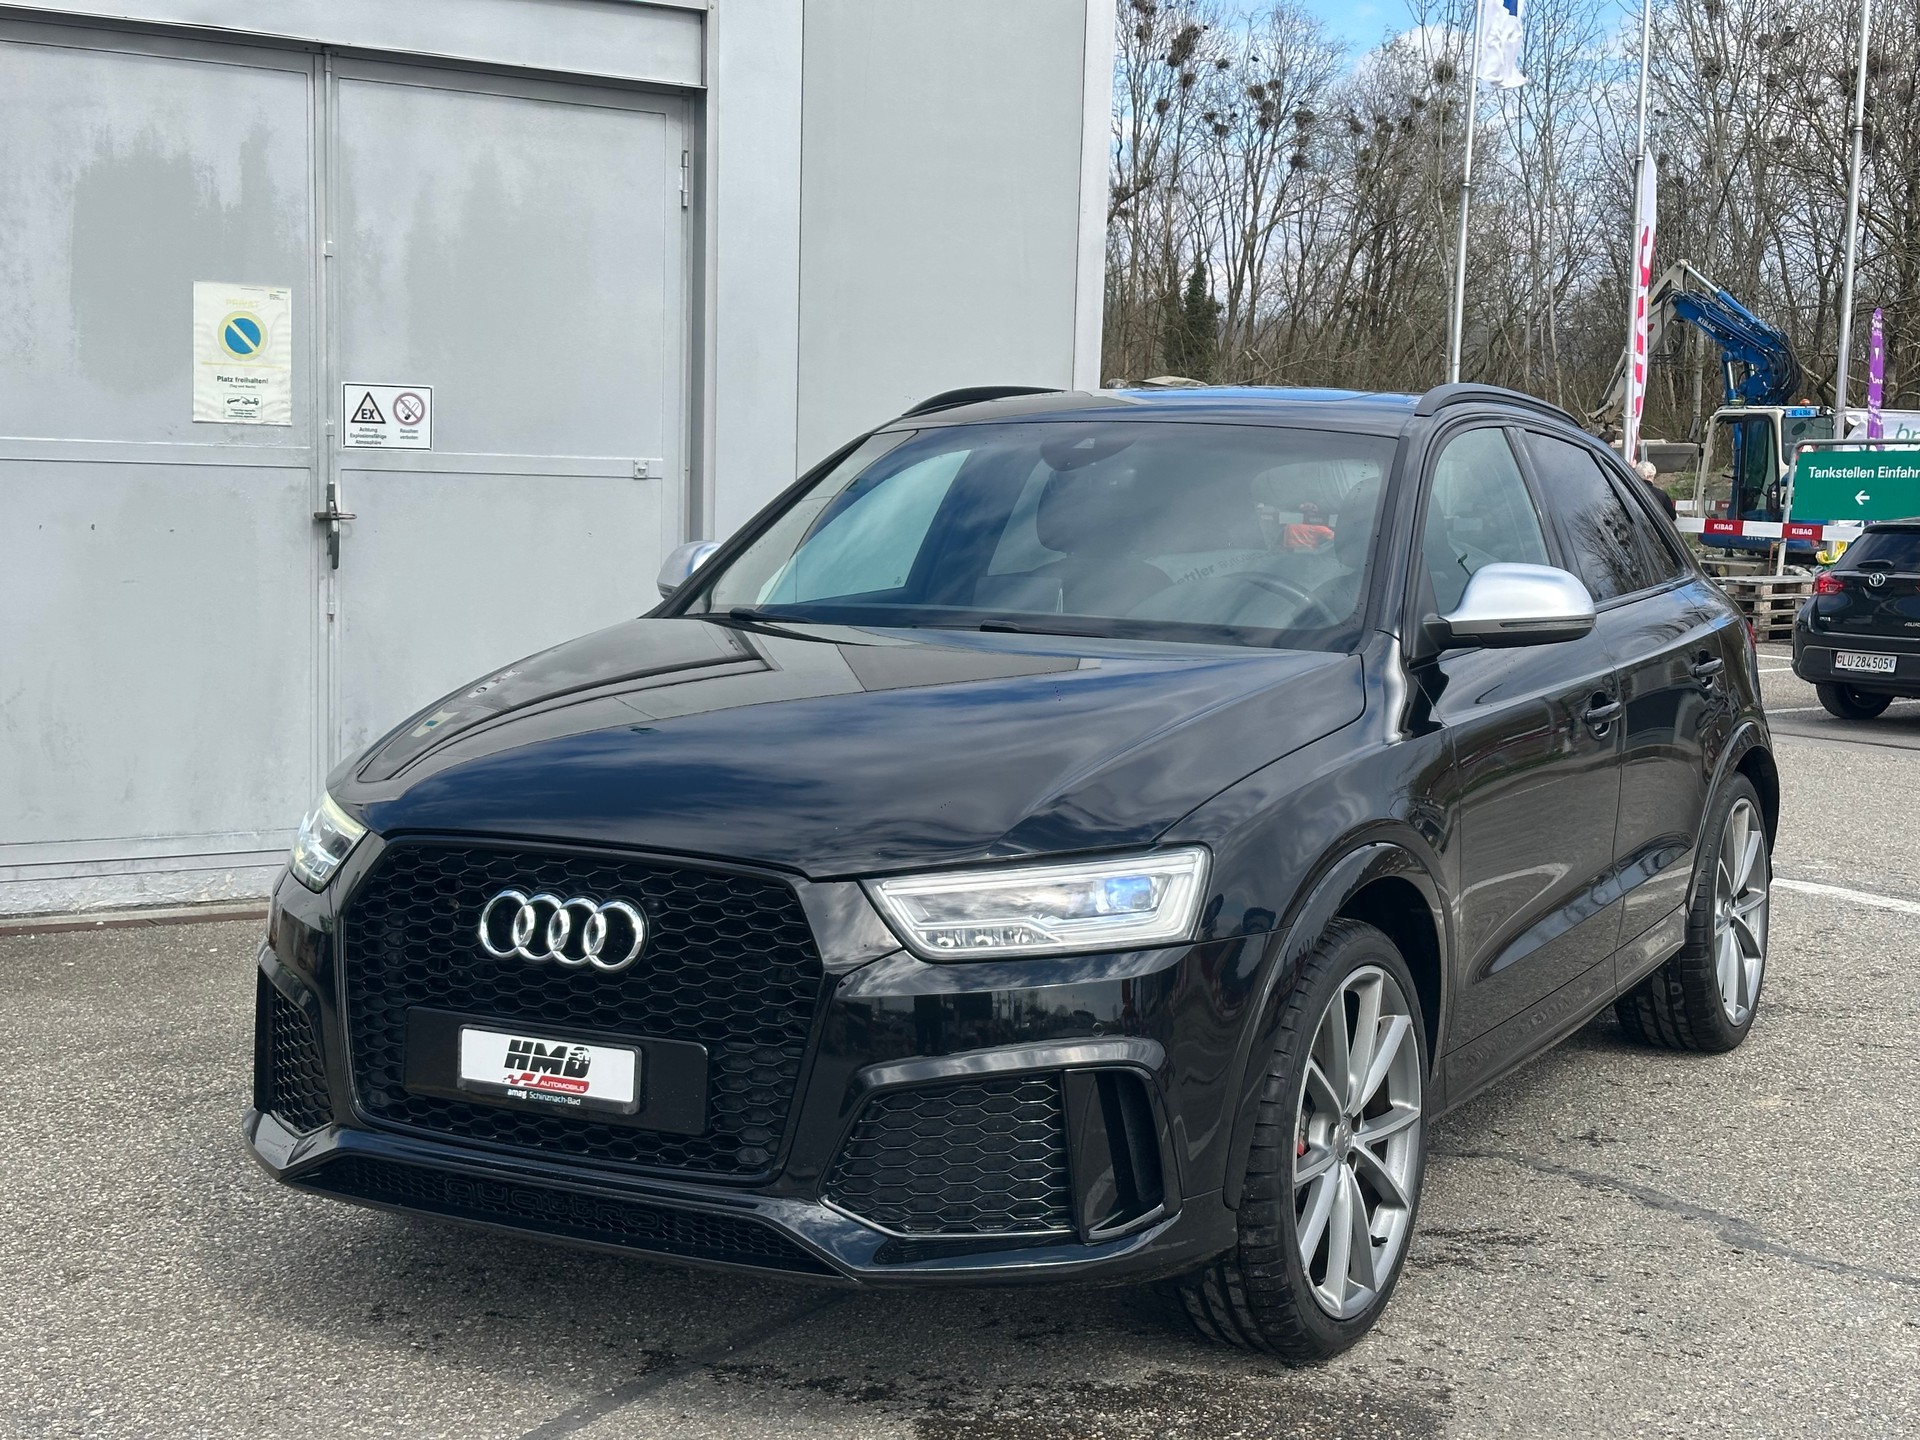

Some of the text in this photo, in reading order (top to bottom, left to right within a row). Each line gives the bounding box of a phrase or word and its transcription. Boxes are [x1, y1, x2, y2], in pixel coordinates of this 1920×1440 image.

[1697, 316, 1717, 333] KIBAG
[216, 375, 234, 383] Platz
[361, 408, 376, 420] EX
[1808, 466, 1875, 478] Tankstellen
[1713, 523, 1734, 531] KIBAG
[1791, 527, 1813, 536] KIBAG
[540, 1080, 585, 1092] AUTOMOBILE
[507, 1088, 581, 1106] amag Schinznach-Bad
[446, 1180, 661, 1229] quattro
